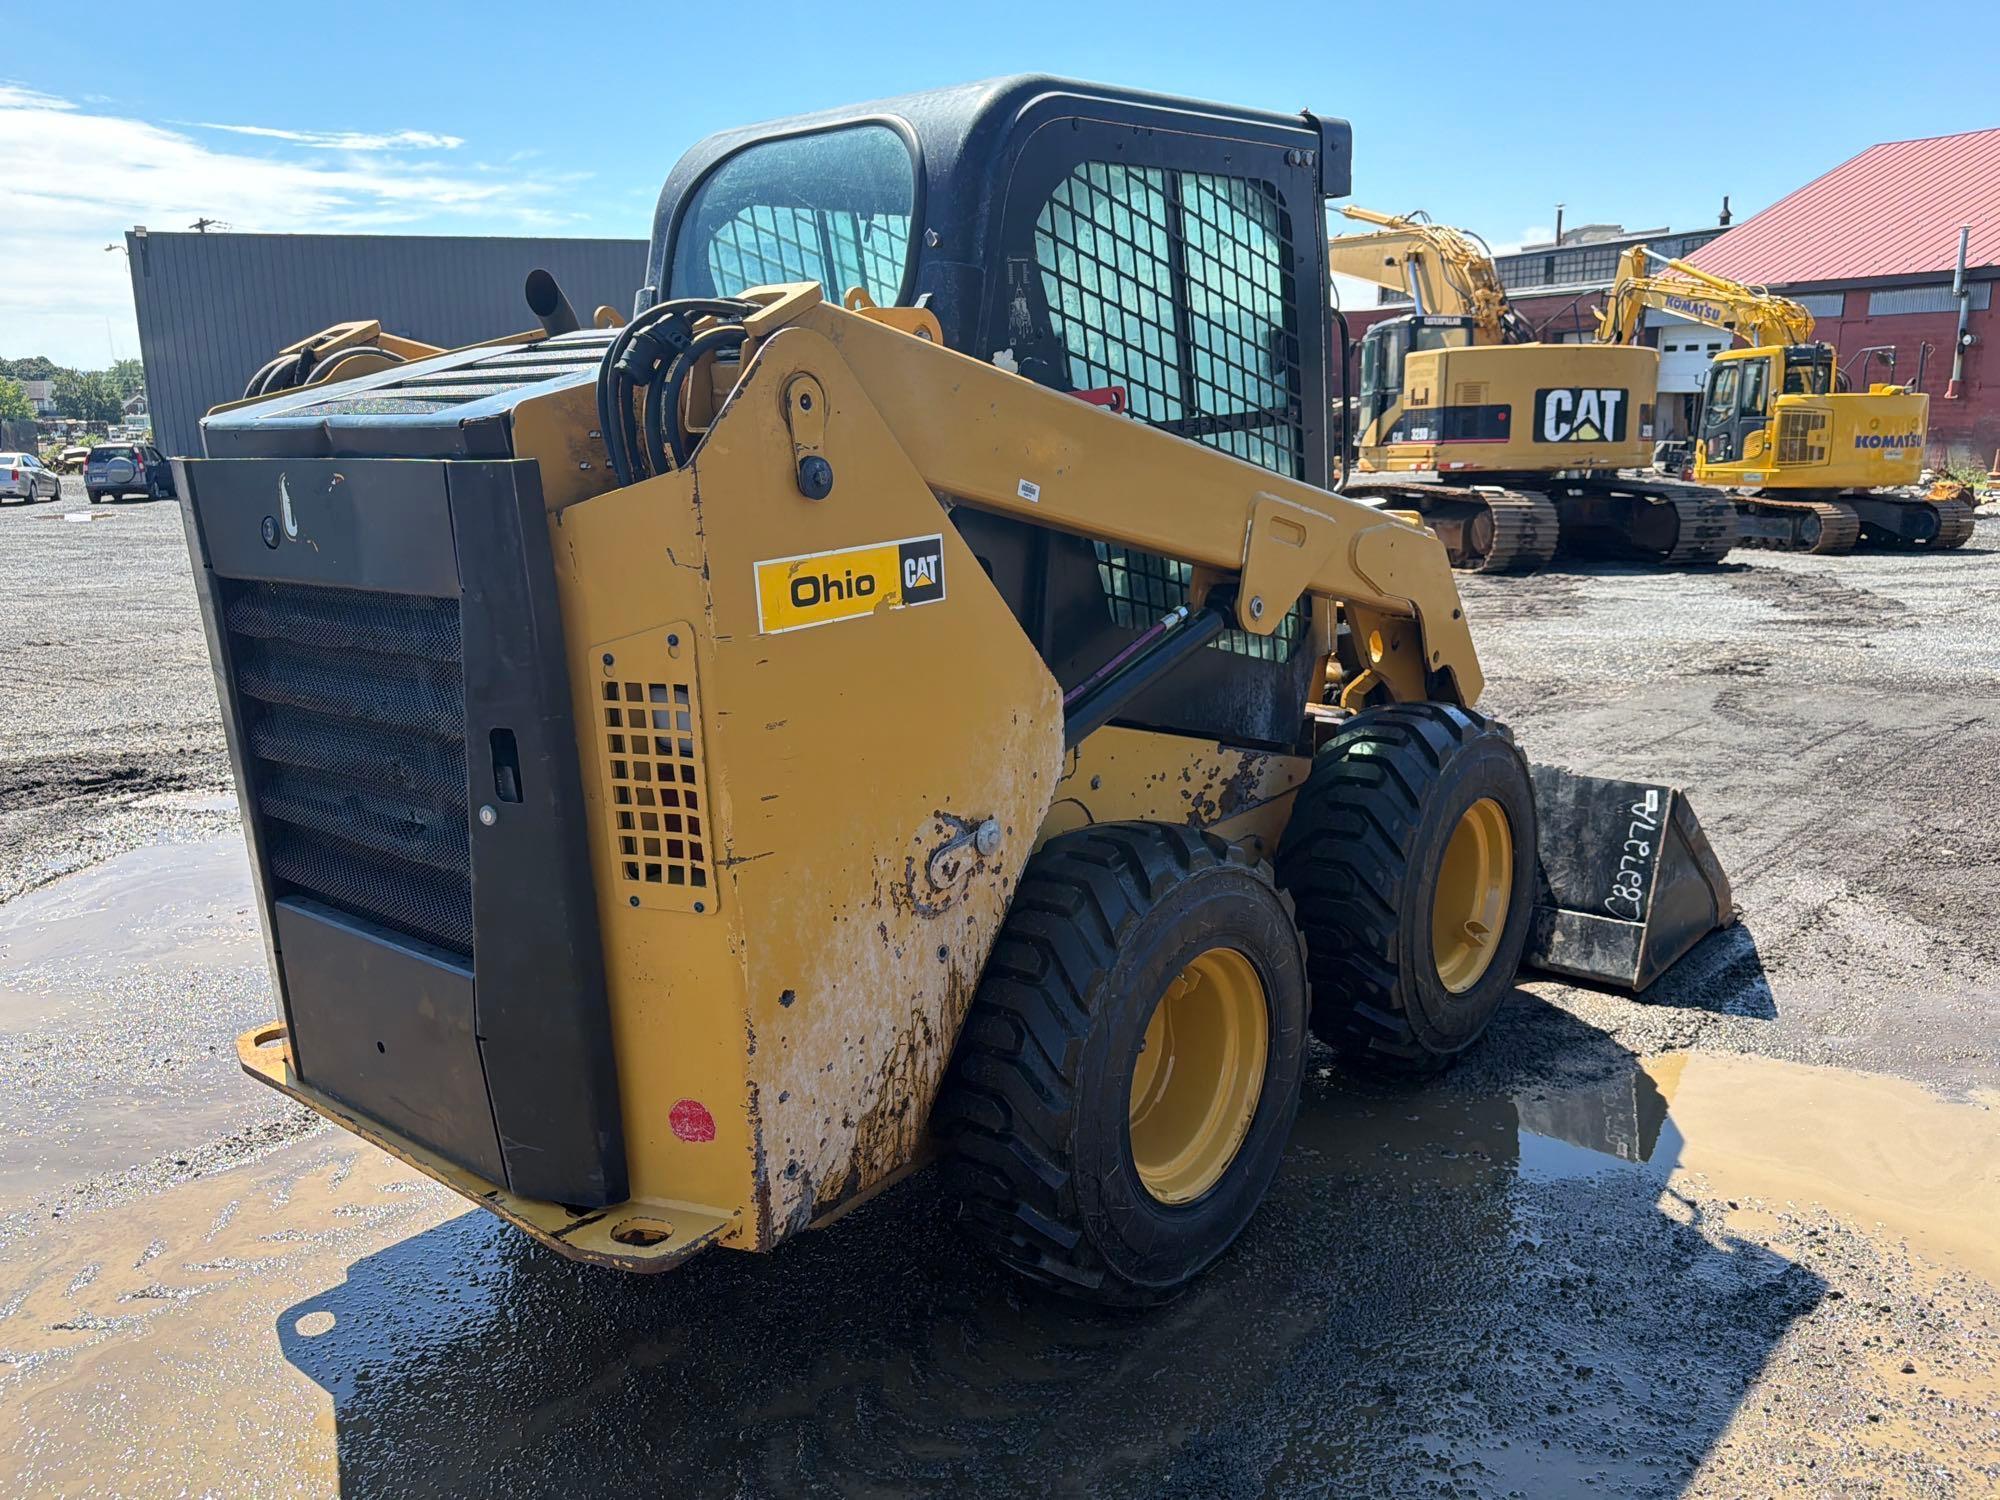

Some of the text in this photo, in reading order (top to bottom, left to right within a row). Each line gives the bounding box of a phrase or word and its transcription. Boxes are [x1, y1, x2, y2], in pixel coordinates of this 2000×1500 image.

[1664, 294, 1721, 321] KOMATSU
[1544, 389, 1622, 443] CAT
[1855, 432, 1922, 448] KOMATSU
[790, 554, 938, 608] Ohio CAT
